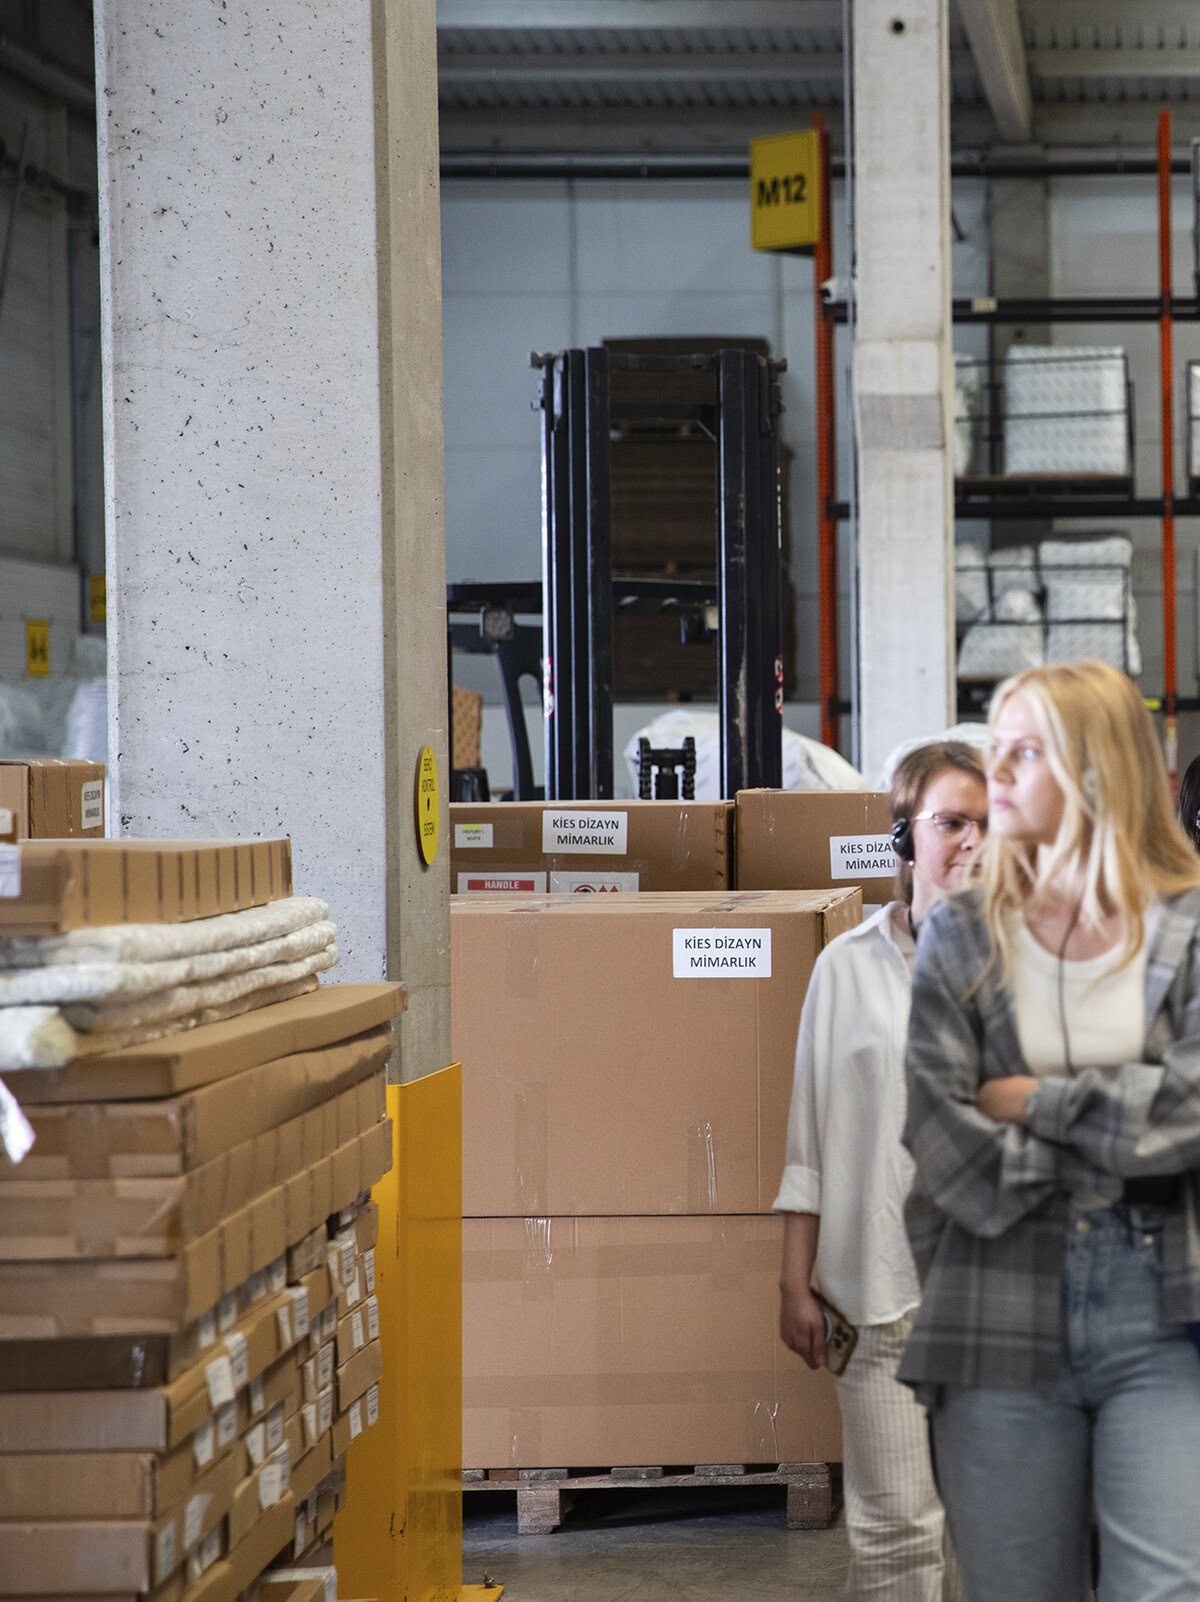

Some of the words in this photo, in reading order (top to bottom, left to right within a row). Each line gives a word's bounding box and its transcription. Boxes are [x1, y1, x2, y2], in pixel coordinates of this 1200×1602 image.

[758, 172, 806, 208] M12
[553, 817, 575, 828] KİES
[579, 818, 619, 829] DİZAYN
[557, 833, 614, 845] MİMARLIK
[840, 842, 863, 854] KİES
[866, 841, 897, 853] DİZA
[846, 858, 898, 870] MİMARLI
[484, 880, 519, 890] HANDLE
[684, 936, 711, 949] KİES
[715, 936, 761, 949] DİZAYN
[690, 955, 756, 967] MİMARLIK
